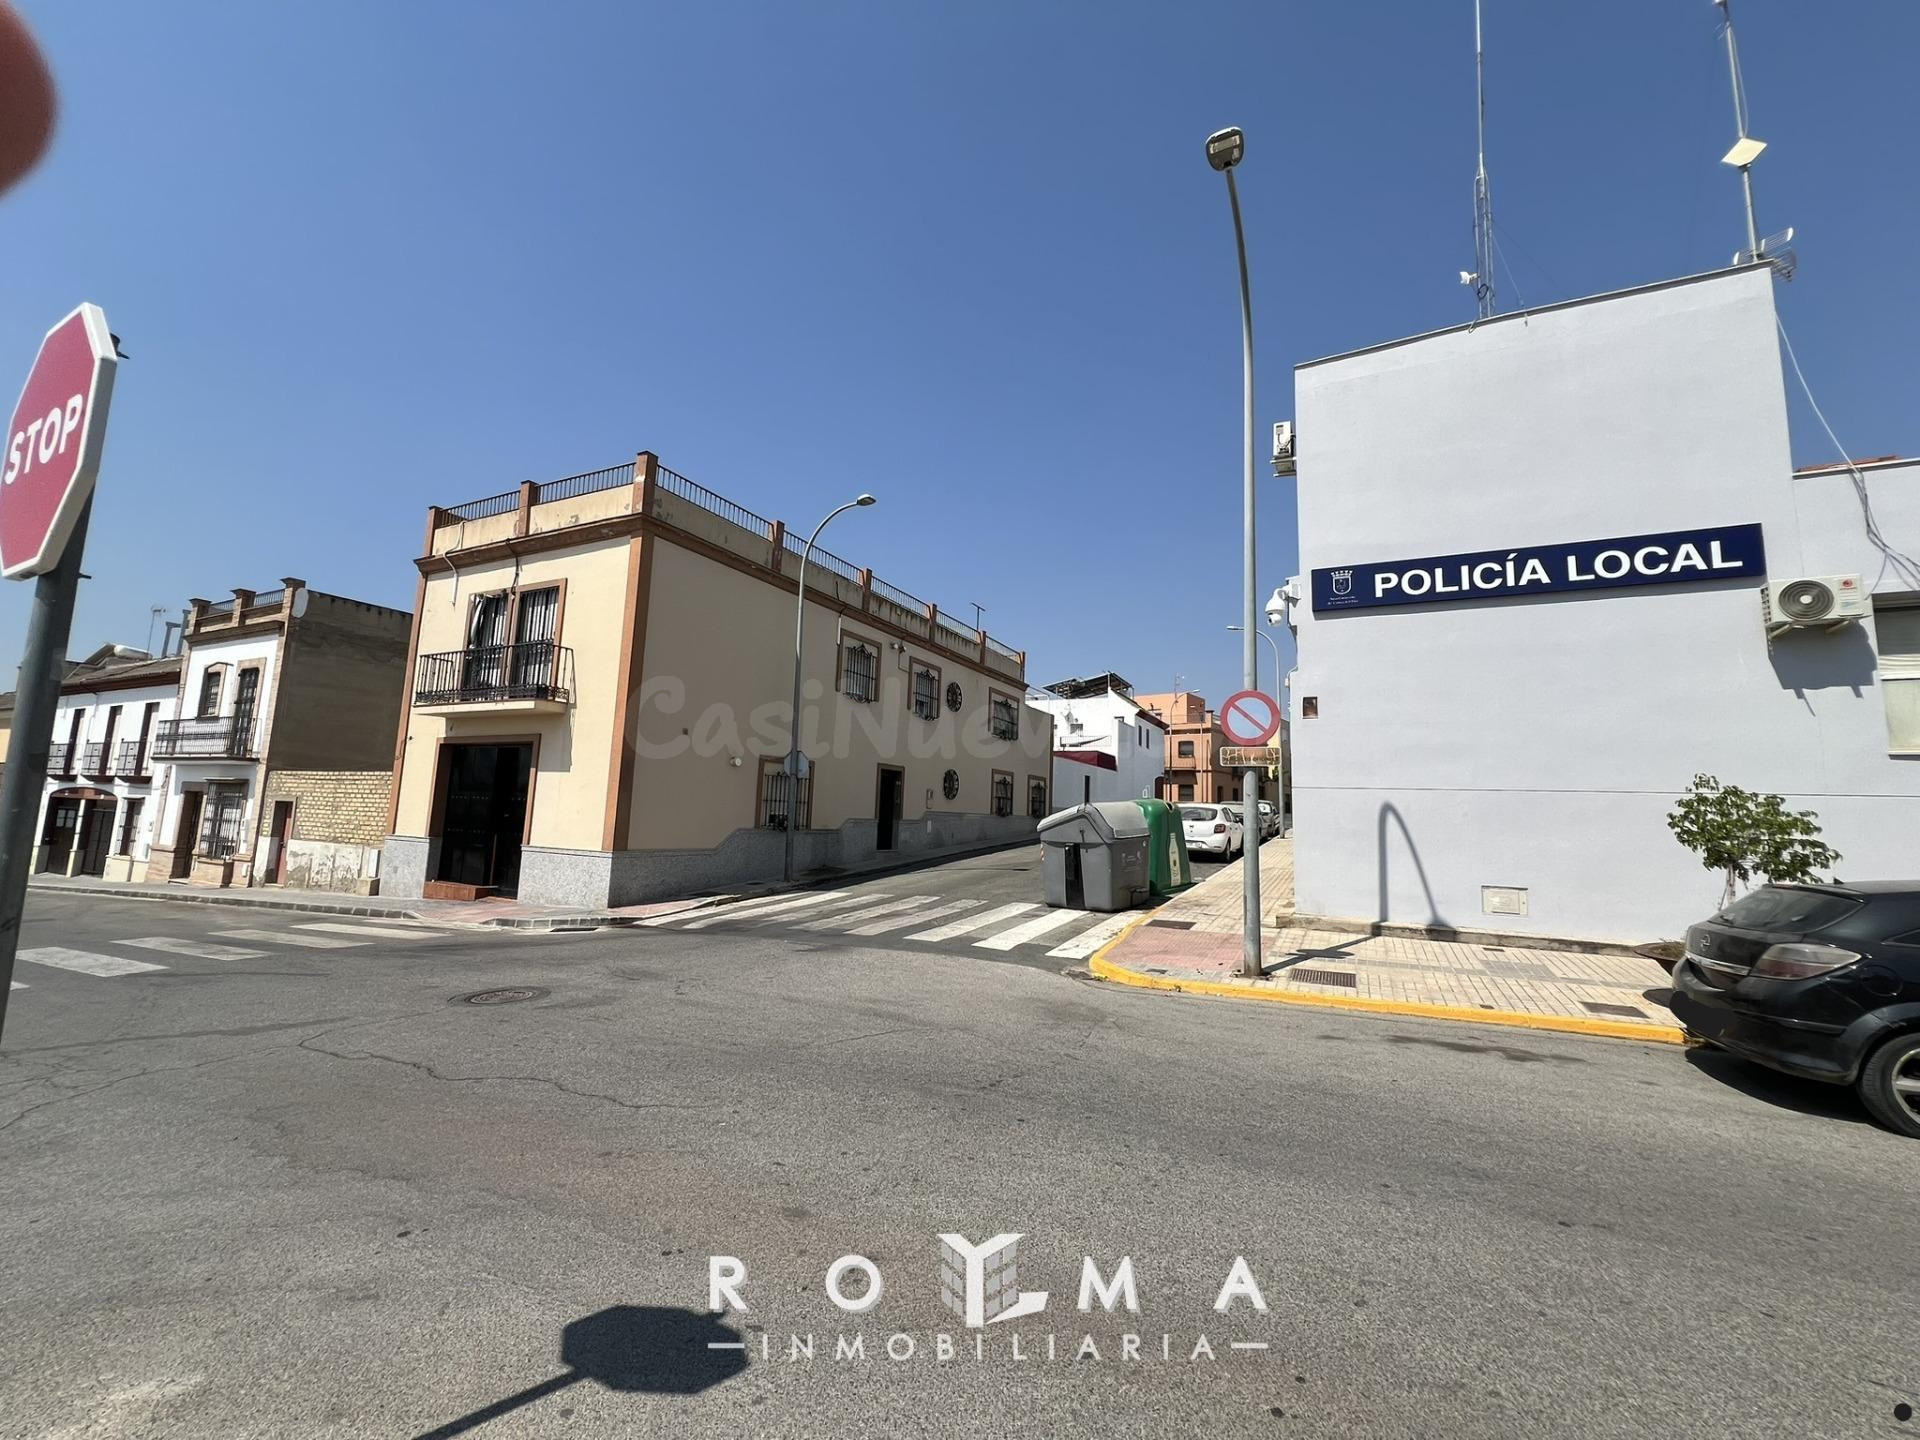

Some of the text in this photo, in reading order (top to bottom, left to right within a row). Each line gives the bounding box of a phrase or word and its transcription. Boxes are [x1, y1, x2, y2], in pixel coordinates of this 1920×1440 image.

[4, 394, 83, 485] STOP
[1374, 541, 1743, 598] POLICÍA LOCAL
